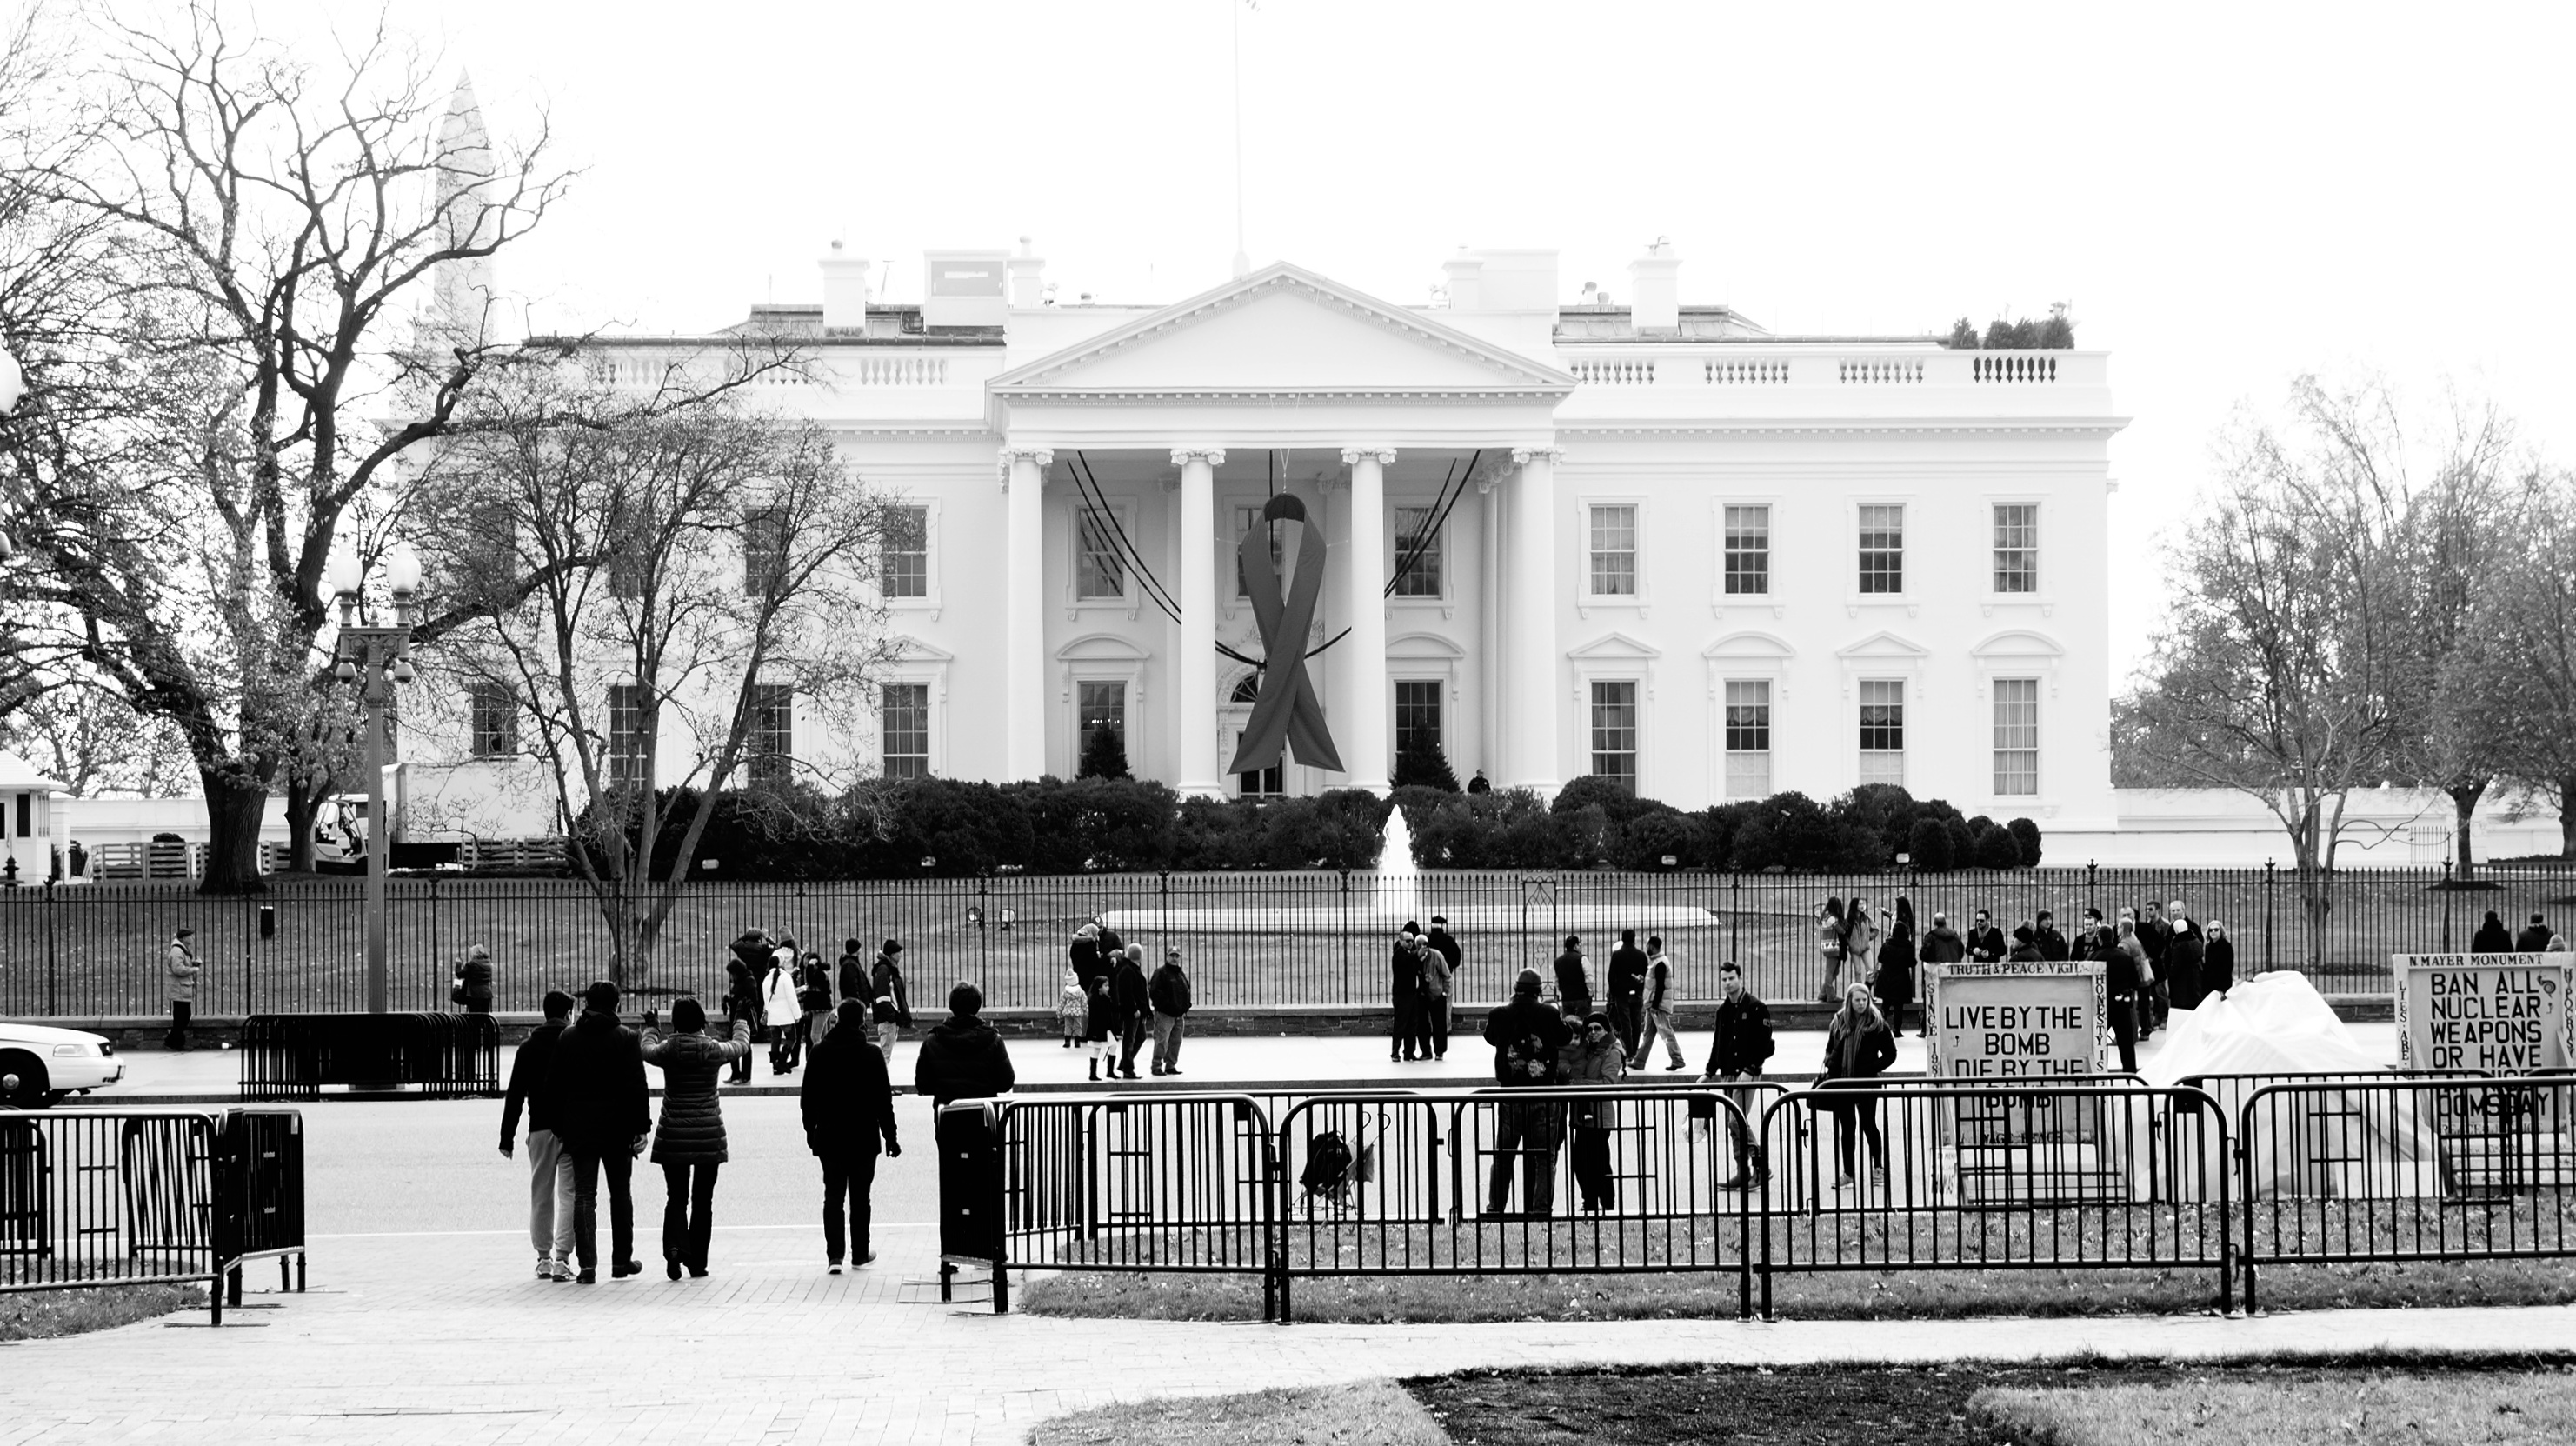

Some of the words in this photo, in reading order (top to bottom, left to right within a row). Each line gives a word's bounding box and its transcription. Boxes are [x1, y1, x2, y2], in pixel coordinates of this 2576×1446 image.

[1947, 963, 1992, 976] TRUTH
[1993, 964, 2000, 975] &
[2001, 963, 2044, 975] PEACE
[2048, 962, 2082, 975] VIGIL
[2420, 956, 2465, 967] MAYER
[2470, 954, 2544, 966] MONUMENT
[2431, 972, 2479, 995] BAN
[2495, 970, 2539, 995] ALL
[1927, 983, 1937, 1036] SINCE
[2094, 974, 2106, 1046] HONESTY
[2399, 980, 2407, 1023] LIES
[2431, 996, 2541, 1020] NUCLEAR
[1945, 1006, 1996, 1029] LIVE
[2000, 1006, 2032, 1029] BY
[2035, 1006, 2082, 1029] THE
[2430, 1020, 2542, 1044] WEAPONS
[1985, 1033, 2050, 1056] BOMB
[2400, 1030, 2410, 1061] ARE
[2433, 1045, 2464, 1069] OR
[2480, 1044, 2542, 1069] HAVE
[1955, 1059, 1993, 1077] DIE
[2001, 1059, 2033, 1077] BY
[2038, 1059, 2084, 1077] THE
[2096, 1050, 2105, 1071] IS
[1985, 1085, 2052, 1109] BB
